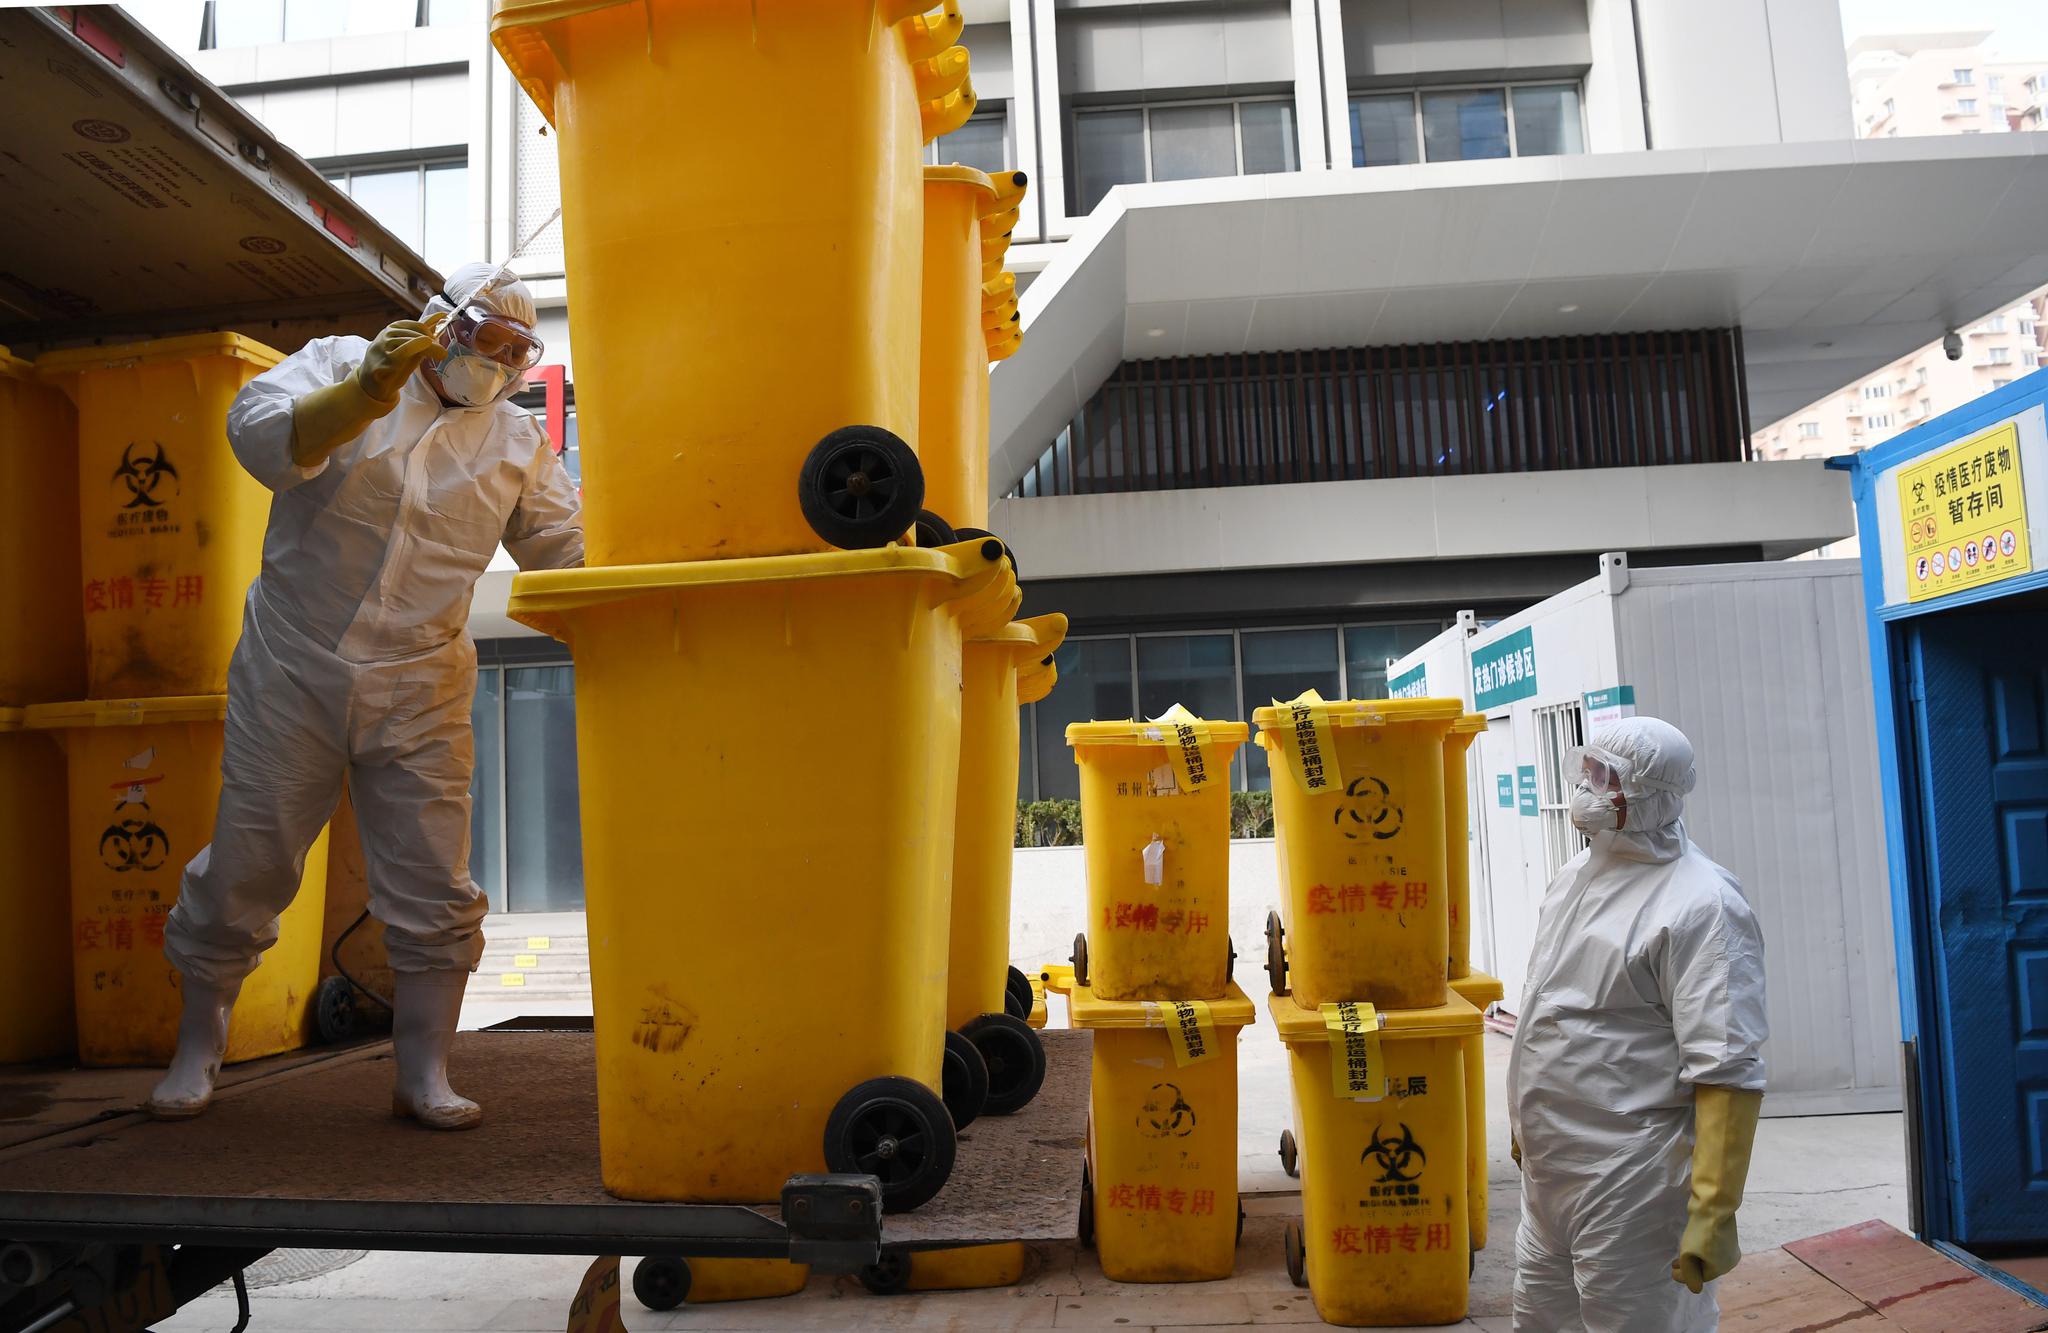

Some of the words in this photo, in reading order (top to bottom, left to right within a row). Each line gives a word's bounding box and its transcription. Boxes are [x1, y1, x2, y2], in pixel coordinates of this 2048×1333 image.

[1934, 445, 2011, 498] 疫情医疗废物
[1948, 484, 2004, 525] 暂存间
[85, 575, 204, 613] 疫情专用
[1473, 647, 1535, 695] 发热门诊候诊区
[1174, 723, 1208, 785] 废物转运桶封条
[1307, 880, 1428, 915] 疫情专用
[76, 913, 165, 951] 疫情专
[1108, 1183, 1216, 1216] 疫情专用
[1332, 1222, 1450, 1256] 疫情专用
